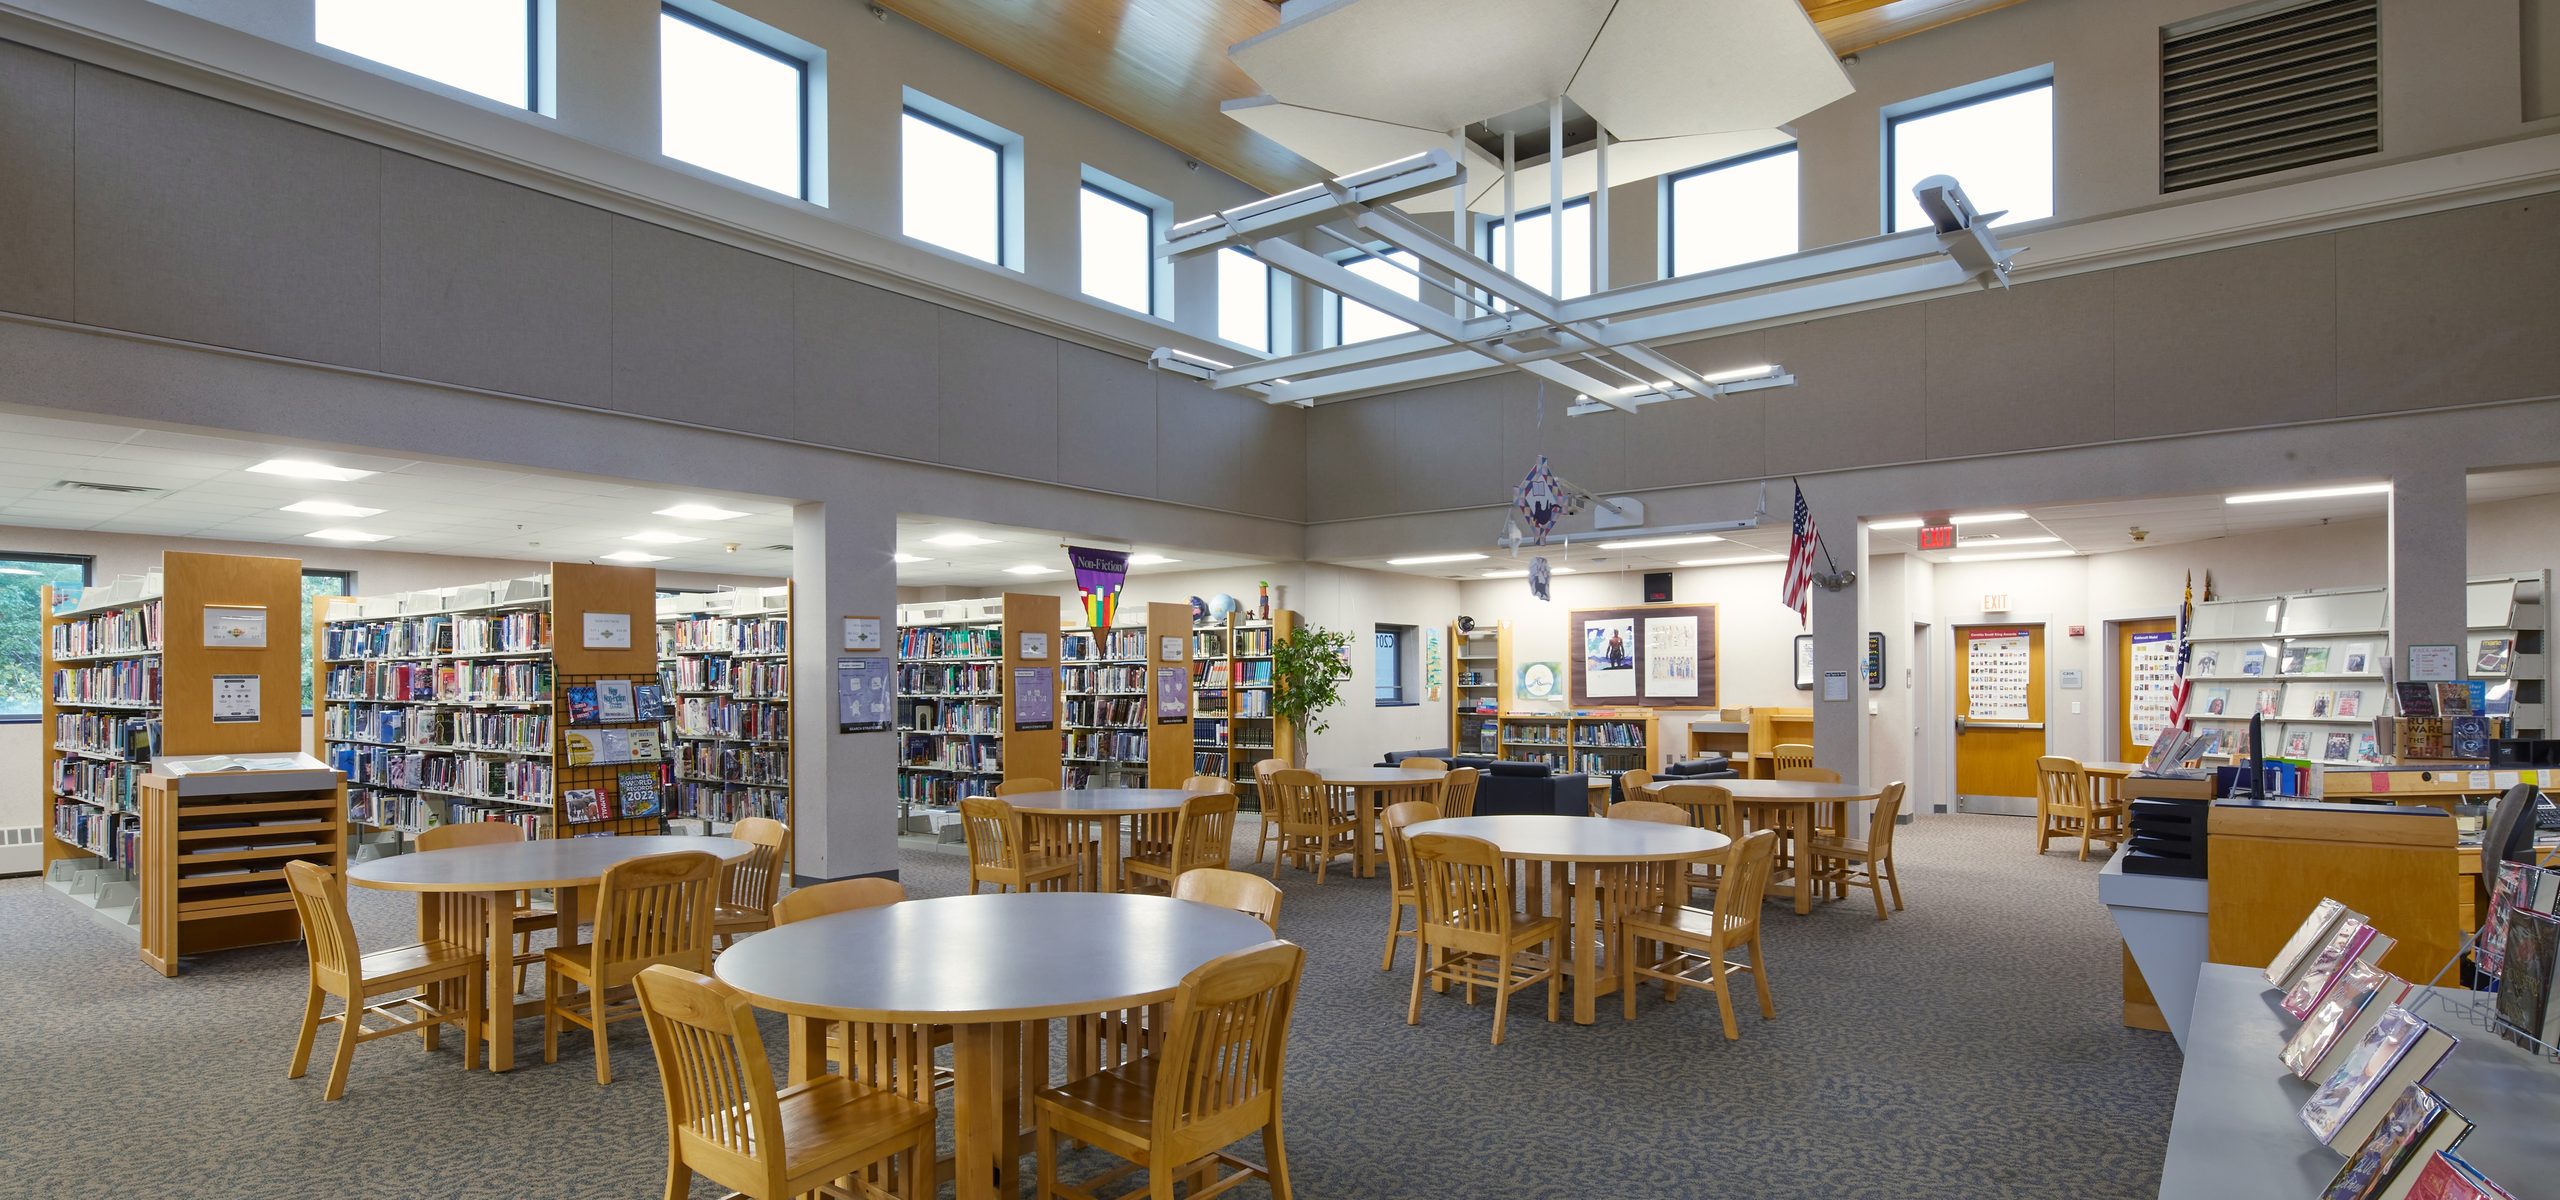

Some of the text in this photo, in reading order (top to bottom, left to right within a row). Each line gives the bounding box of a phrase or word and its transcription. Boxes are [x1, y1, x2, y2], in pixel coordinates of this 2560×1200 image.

[1921, 526, 1952, 549] EXIT
[1077, 556, 1122, 572] Non-Fiction
[1984, 594, 2008, 609] EXIT
[2408, 726, 2443, 734] WARE
[625, 779, 653, 787] WORLD
[627, 790, 655, 801] 2022
[599, 792, 609, 819] MAMMALS
